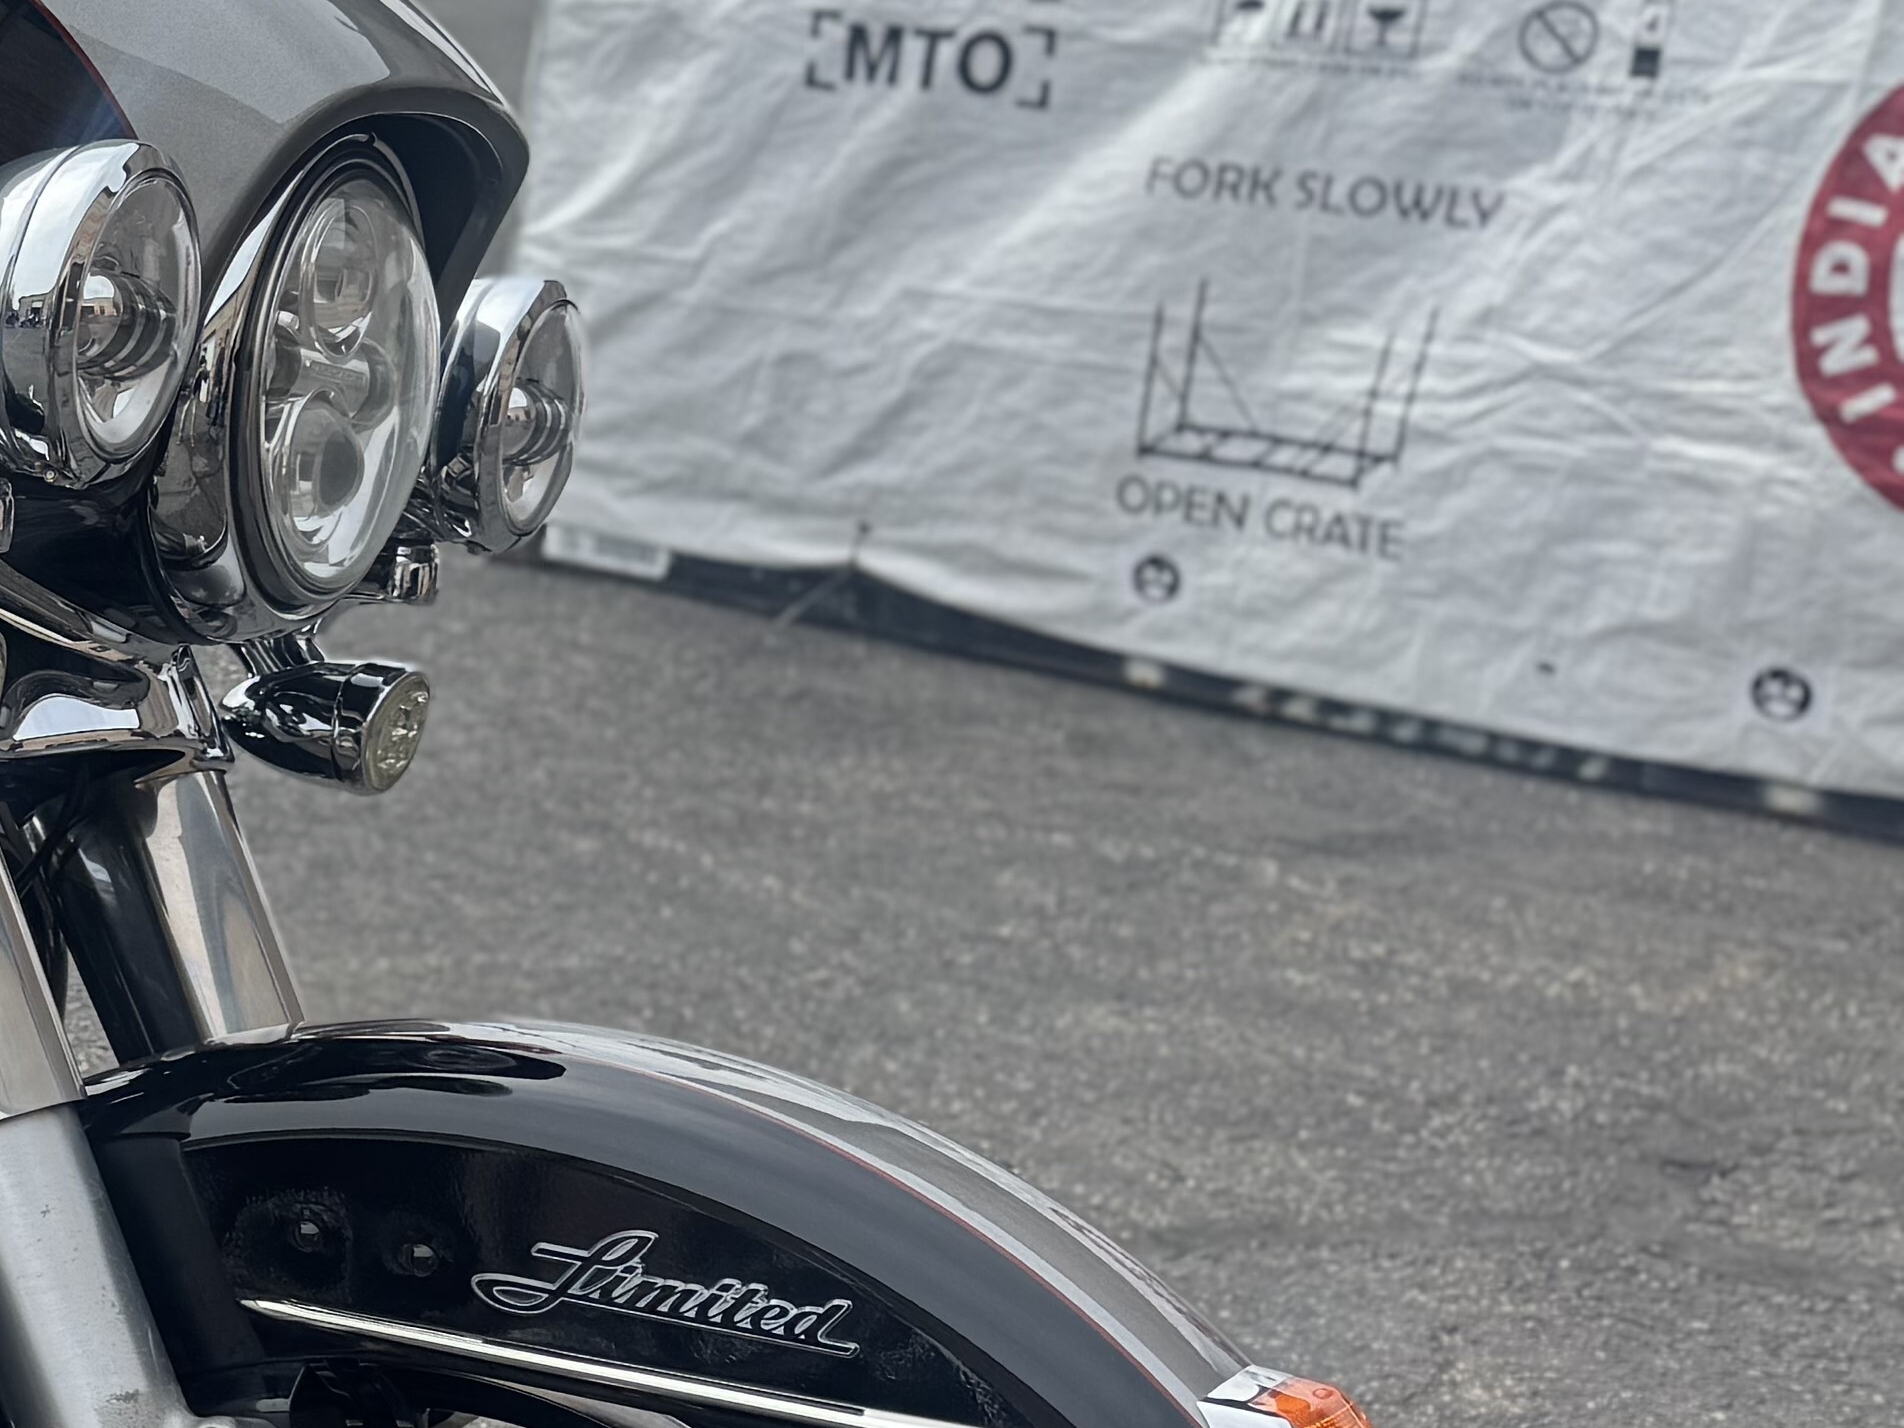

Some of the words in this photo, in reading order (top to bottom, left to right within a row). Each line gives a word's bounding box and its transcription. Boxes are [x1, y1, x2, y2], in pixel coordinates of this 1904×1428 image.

[842, 23, 1014, 96] MTO
[1146, 157, 1283, 208] FORK
[1294, 169, 1507, 229] SLOWLY
[1115, 473, 1251, 531] OPEN
[1263, 498, 1405, 561] CRATE
[471, 1229, 860, 1358] Limited
